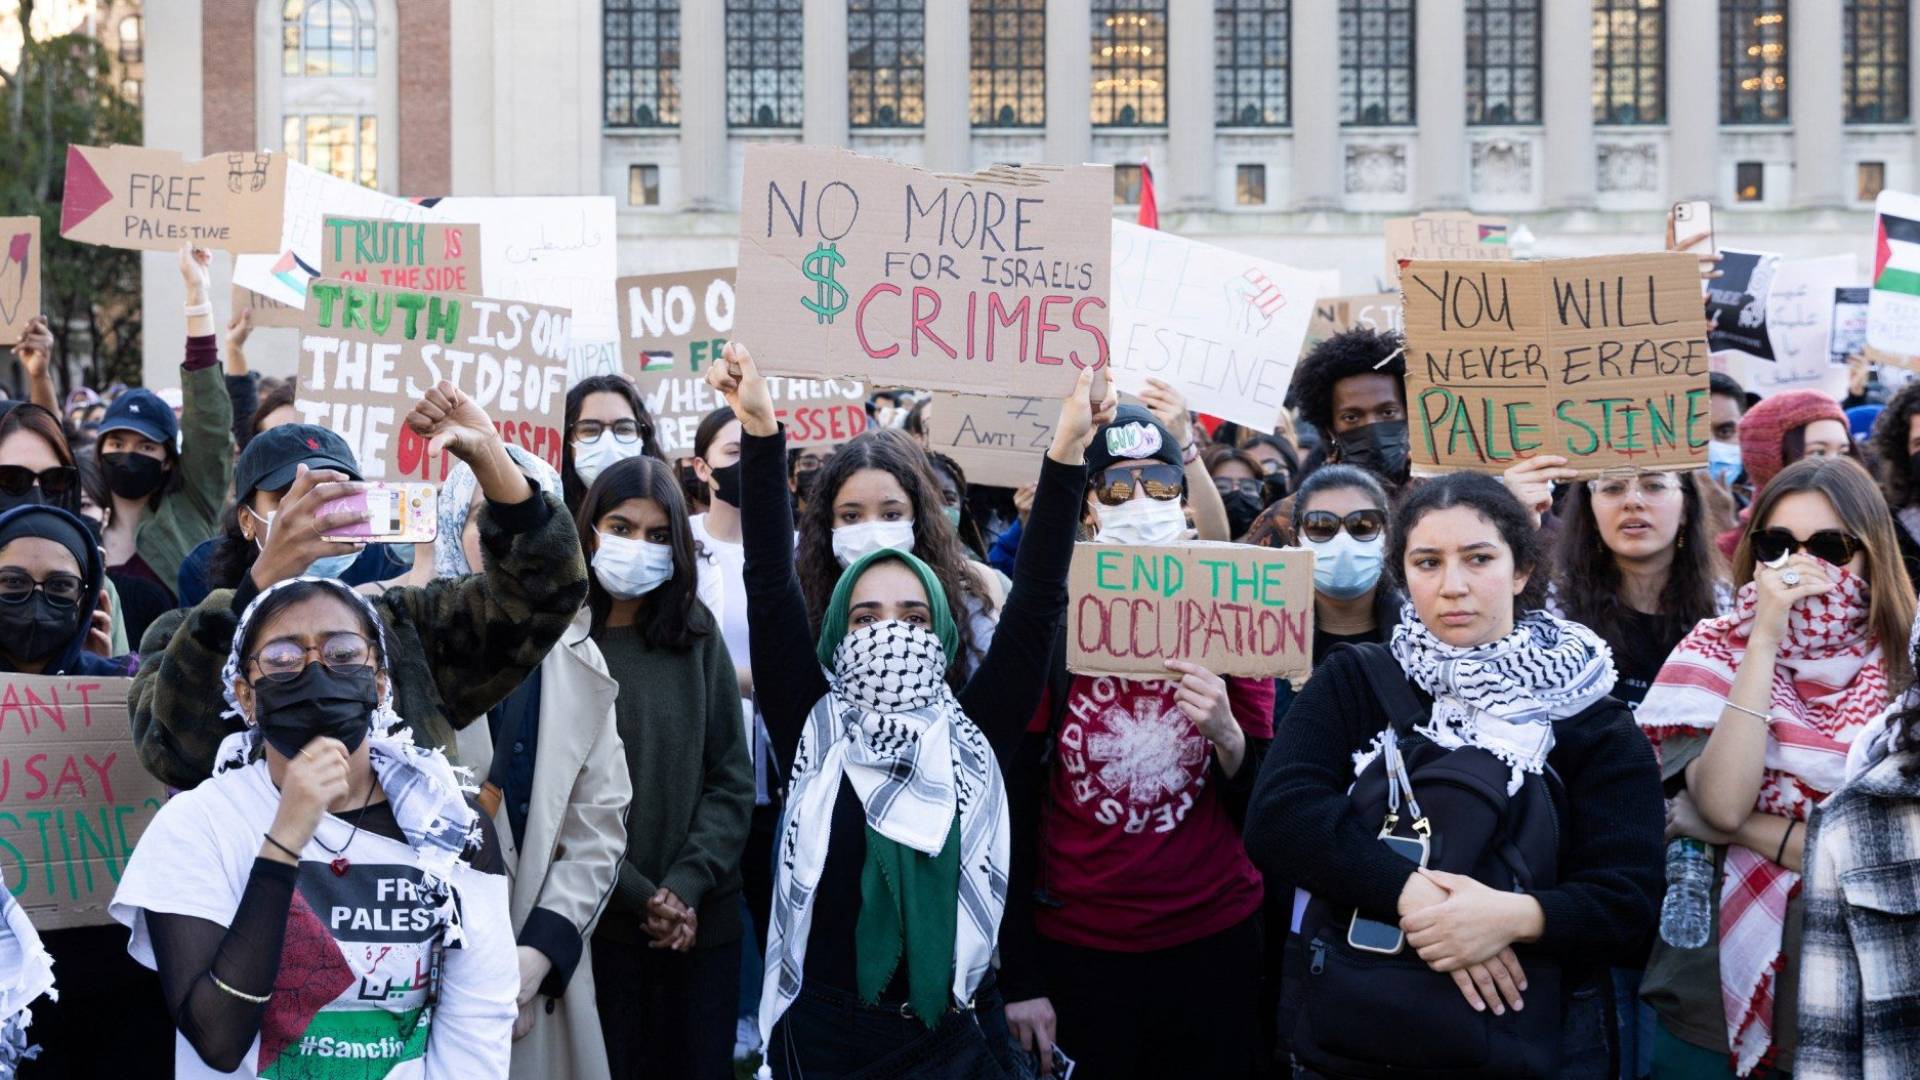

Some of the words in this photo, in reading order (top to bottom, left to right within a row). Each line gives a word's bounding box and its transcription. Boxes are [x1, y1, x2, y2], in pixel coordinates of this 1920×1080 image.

[130, 174, 205, 212] FREE
[767, 180, 859, 241] NO
[905, 184, 1044, 252] MORE
[125, 215, 231, 241] PALESTINE
[325, 218, 426, 266] TRUTH
[444, 228, 463, 260] IS
[1412, 218, 1471, 247] FREE
[801, 242, 848, 324] $
[885, 251, 960, 280] FOR
[981, 255, 1093, 291] ISRAEL'S
[312, 284, 461, 344] TRUTH
[628, 285, 696, 338] NO
[856, 283, 1109, 371] CRIMES
[1413, 270, 1514, 331] YOU
[1554, 274, 1678, 330] WILL
[302, 335, 402, 393] THE
[1426, 344, 1549, 383] NEVER
[1561, 339, 1709, 384] ERASE
[1418, 386, 1709, 464] PALESTINE
[1096, 551, 1183, 597] END
[1199, 561, 1286, 606] THE
[1078, 593, 1307, 659] OCCUPATION
[0, 682, 101, 735] AN'T
[24, 752, 117, 805] SAY
